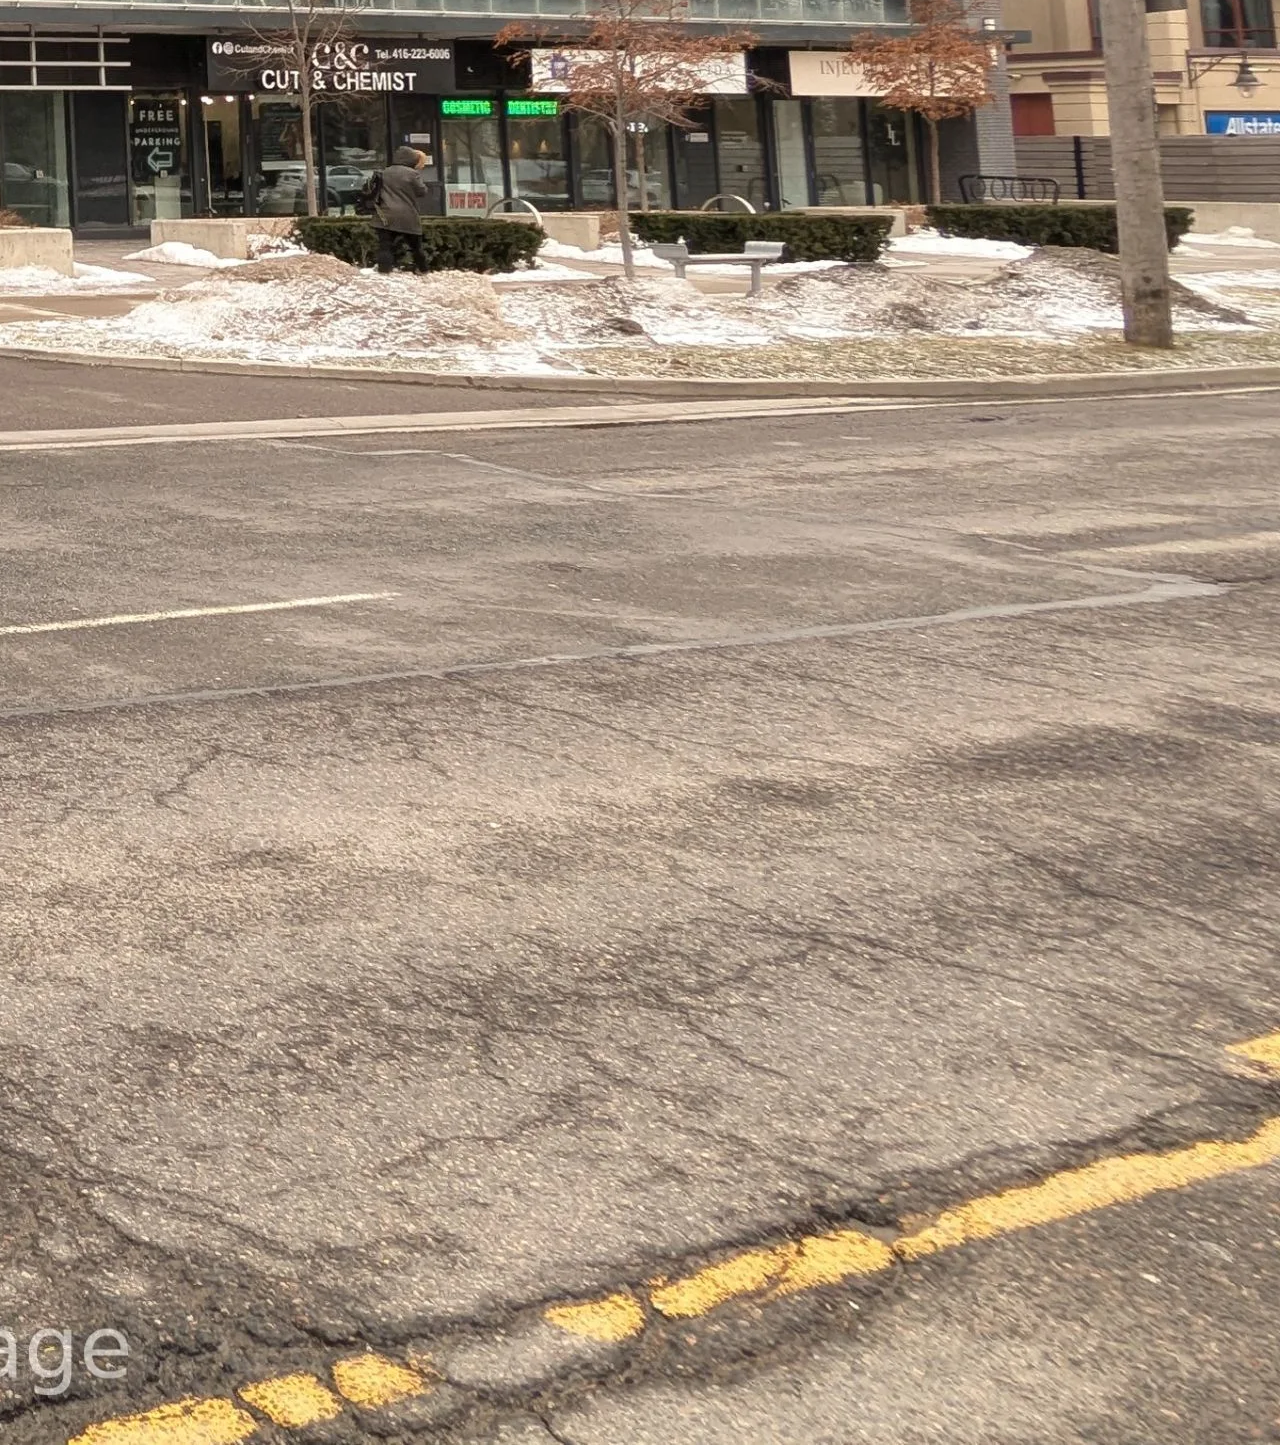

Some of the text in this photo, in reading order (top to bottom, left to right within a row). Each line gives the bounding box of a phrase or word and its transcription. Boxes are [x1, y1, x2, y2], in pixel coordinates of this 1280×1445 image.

[312, 41, 369, 70] C&C
[261, 69, 417, 91] CUT & CHEMIST
[442, 100, 491, 114] COSMETIC
[139, 110, 174, 121] FREE
[1225, 117, 1280, 134] Allstate
[134, 137, 181, 146] PARKING
